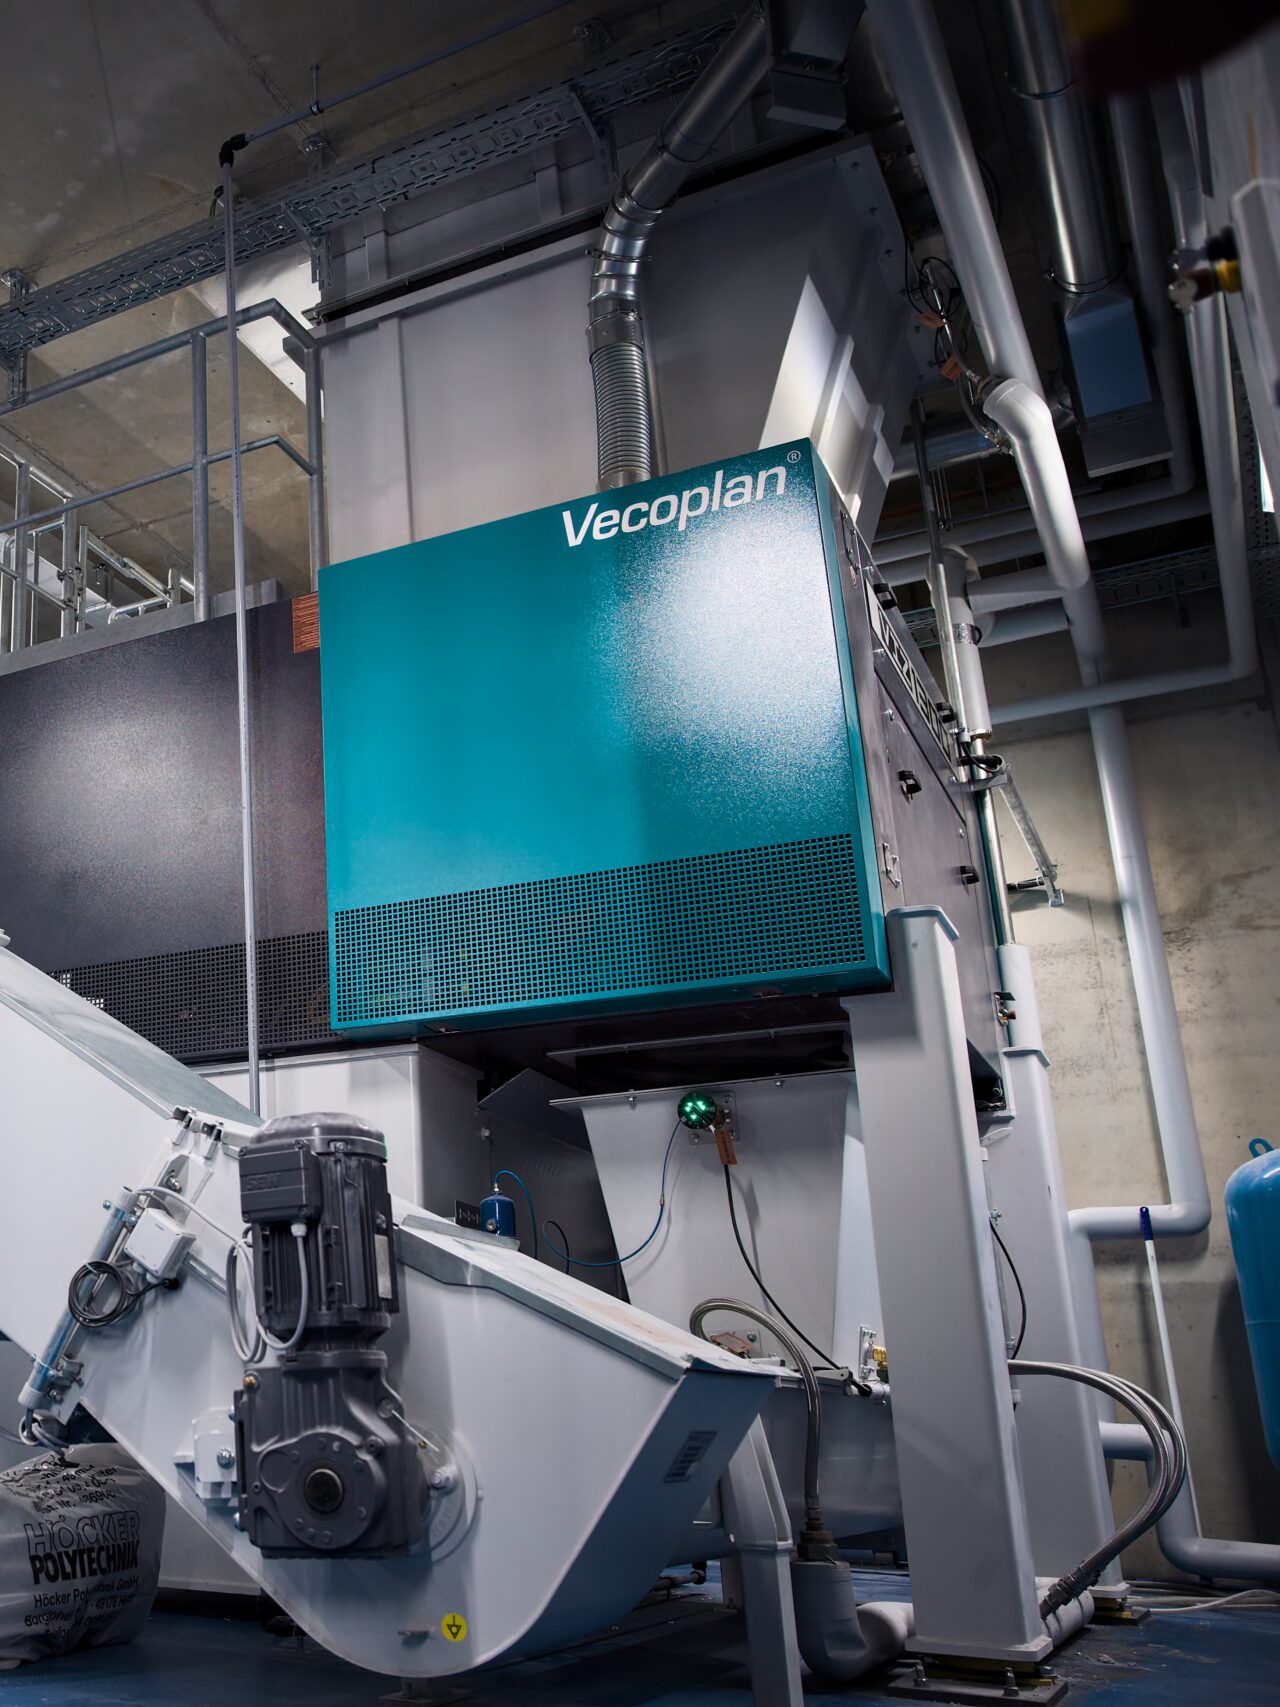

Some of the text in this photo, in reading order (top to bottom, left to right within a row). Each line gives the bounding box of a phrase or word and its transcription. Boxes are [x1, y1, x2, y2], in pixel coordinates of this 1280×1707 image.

[562, 466, 788, 548] Vecoplan
[24, 1511, 140, 1555] HÖCKER
[30, 1540, 140, 1584] POLYTECHNIK
[34, 1589, 69, 1608] Höcker
